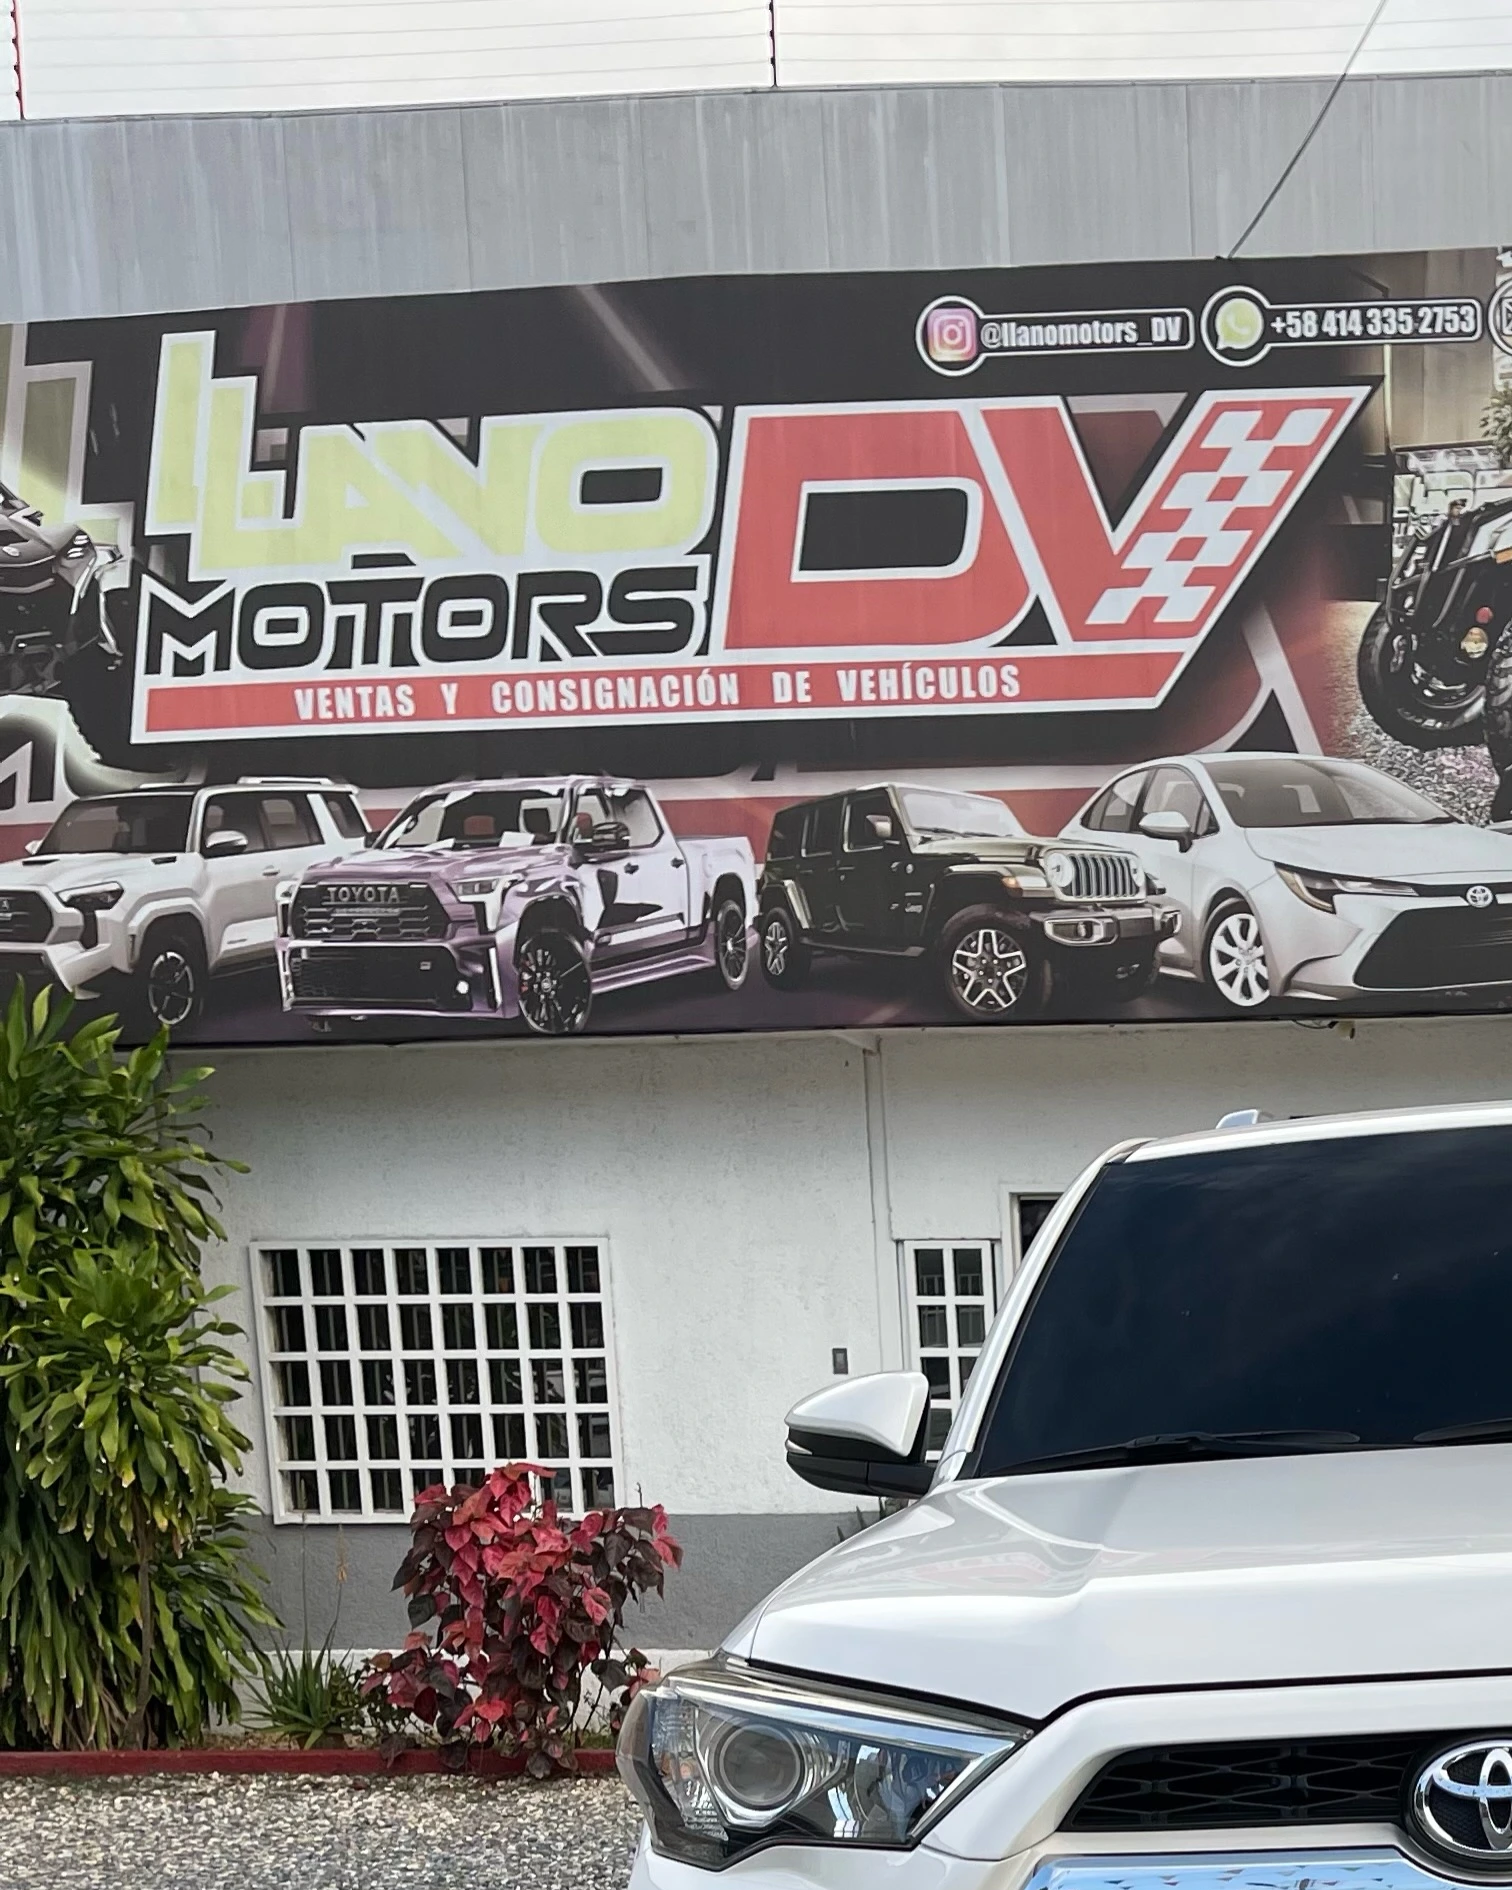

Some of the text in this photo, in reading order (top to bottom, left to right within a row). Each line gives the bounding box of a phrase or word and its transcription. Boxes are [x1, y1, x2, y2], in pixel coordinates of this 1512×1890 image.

[980, 316, 1182, 349] @llanomotors_DV
[1270, 311, 1318, 338] +58
[1321, 308, 1363, 337] 414
[146, 330, 718, 578] LLANO
[718, 386, 1372, 650] DV
[143, 566, 702, 677] MOTORS
[294, 664, 1021, 721] VENTAS Y CONSIGNACIÓN DE VEHÍCULOS
[327, 886, 401, 904] TOYOTA
